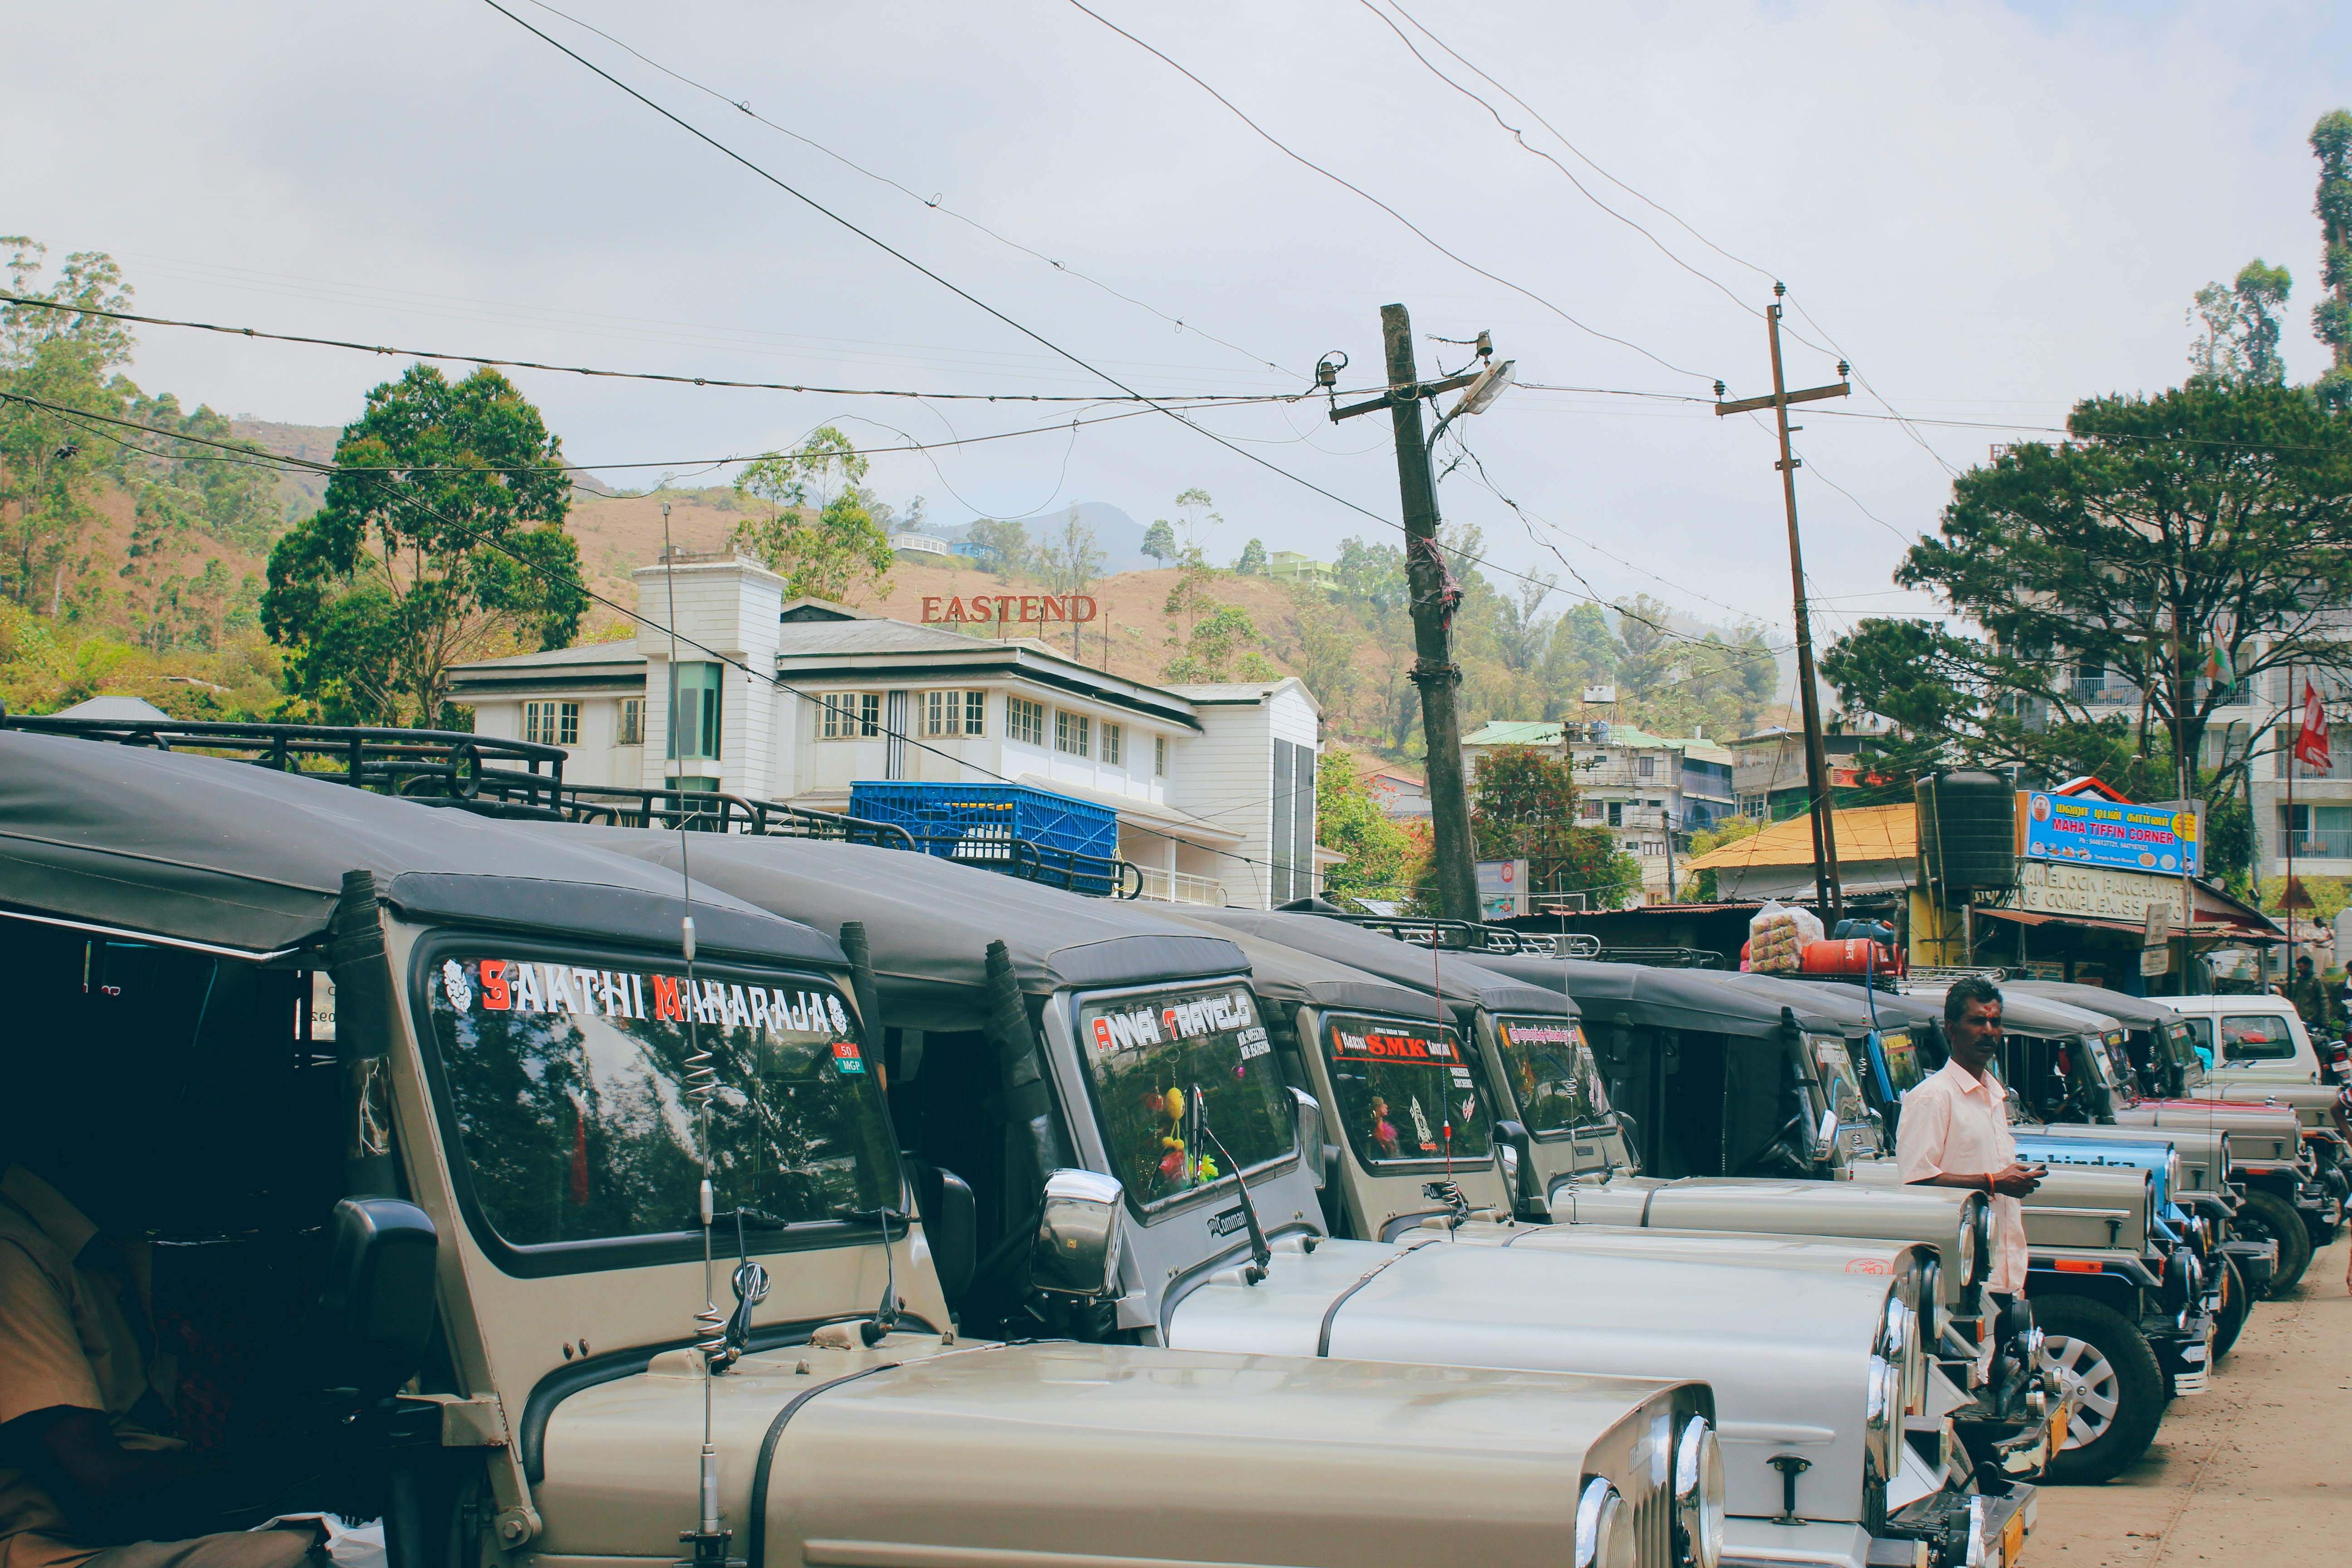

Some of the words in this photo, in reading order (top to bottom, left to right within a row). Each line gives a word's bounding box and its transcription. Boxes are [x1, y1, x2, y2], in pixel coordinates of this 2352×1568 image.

[921, 595, 1097, 623] EASTEND
[2053, 818, 2087, 834] MAHA
[2089, 823, 2127, 839] TIFFIN
[2129, 828, 2175, 845] CORNER
[2103, 877, 2184, 900] PANCHAYAT
[480, 960, 646, 1019] SAKTHI
[652, 975, 831, 1034] MAHARAJA
[1162, 994, 1252, 1041] TRAVELS
[841, 1046, 852, 1056] 50
[1366, 1034, 1429, 1058] SMK
[843, 1060, 860, 1070] MGP
[1216, 1210, 1247, 1234] Comman
